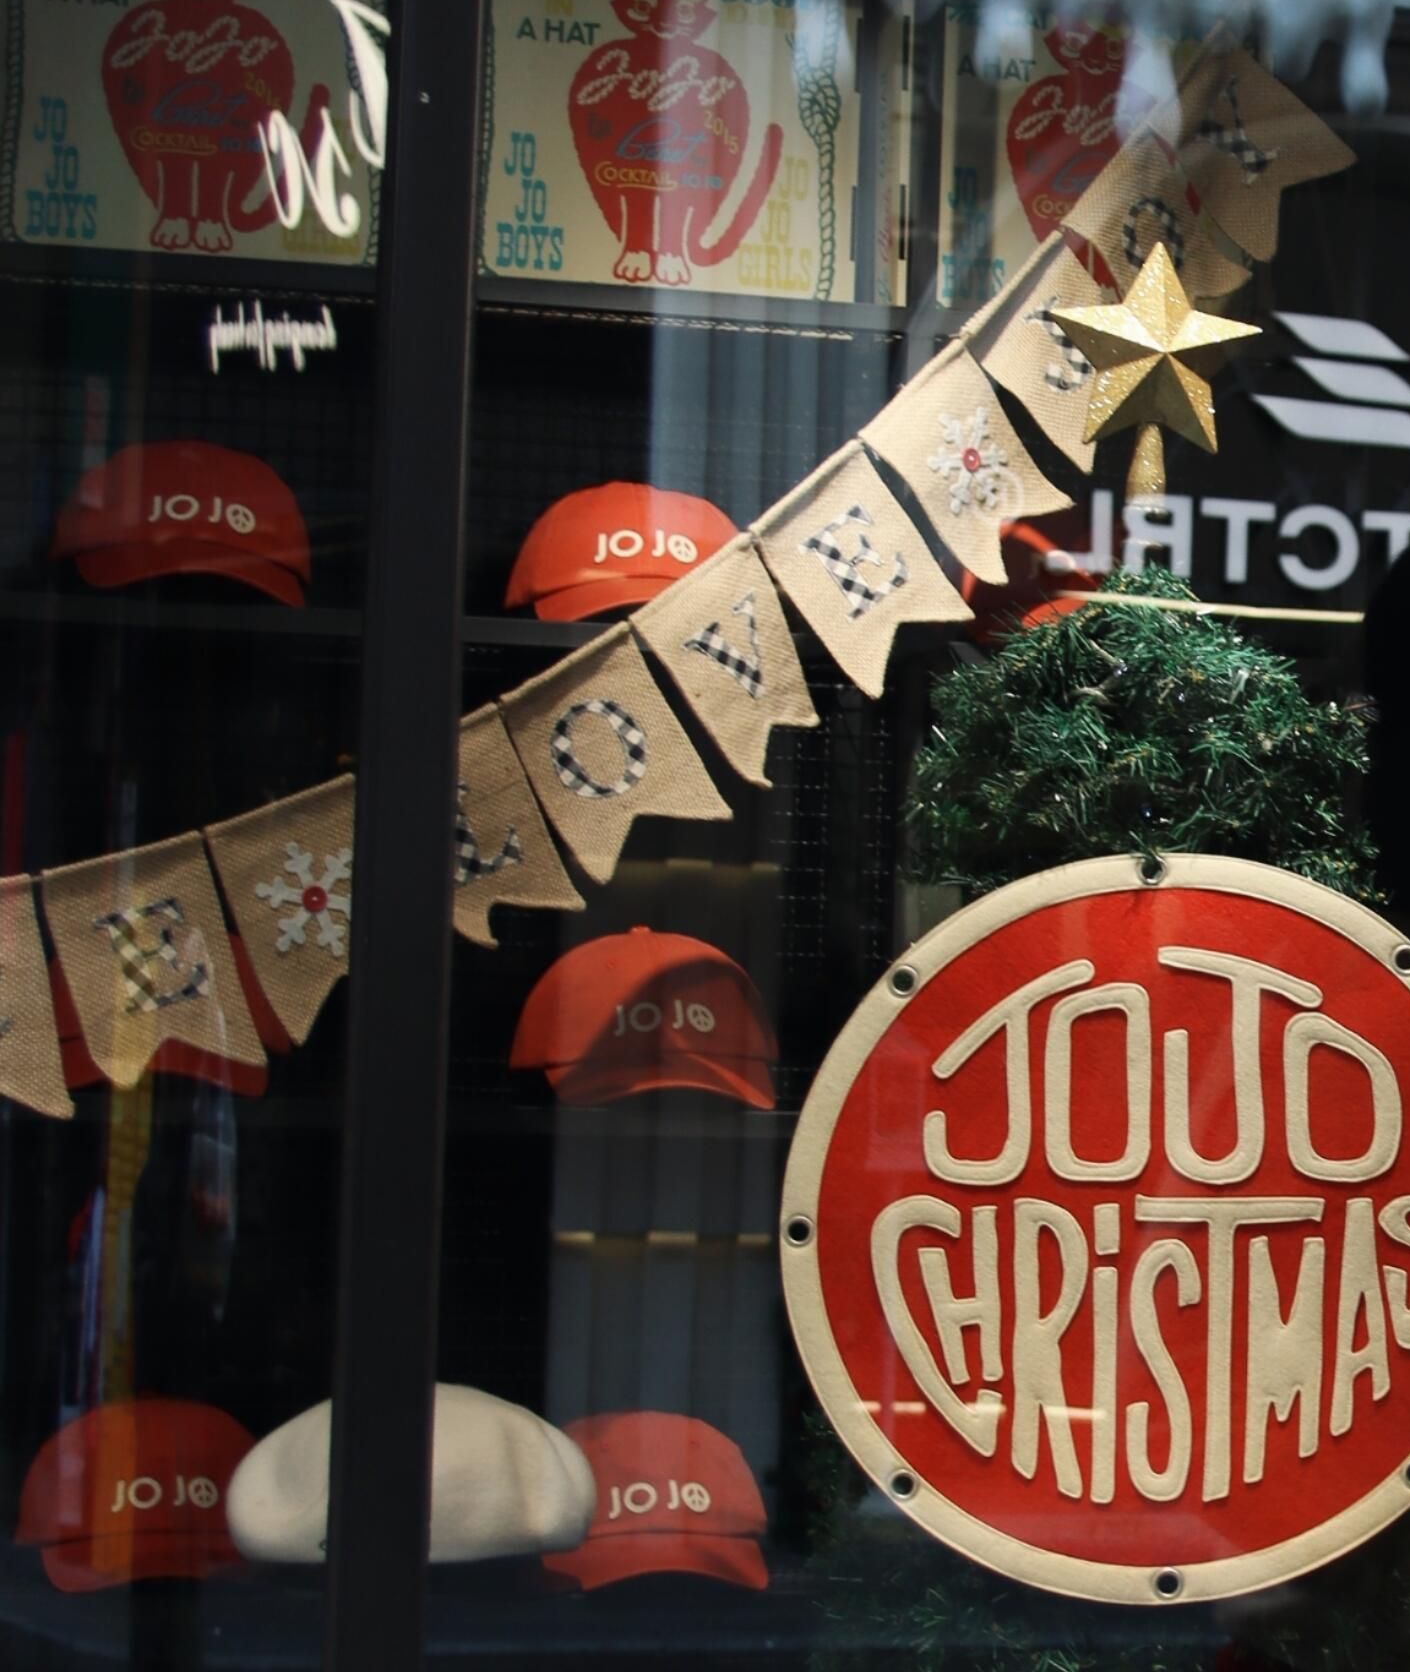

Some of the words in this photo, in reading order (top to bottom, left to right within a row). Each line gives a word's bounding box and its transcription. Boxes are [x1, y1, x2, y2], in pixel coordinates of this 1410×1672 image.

[517, 17, 536, 40] A
[545, 18, 600, 46] HAT
[504, 131, 536, 176] JO
[24, 190, 97, 239] BOYS
[515, 179, 547, 223] JO
[495, 222, 564, 272] BOYS
[738, 242, 812, 292] GIRLS
[923, 945, 1403, 1186] JOJO
